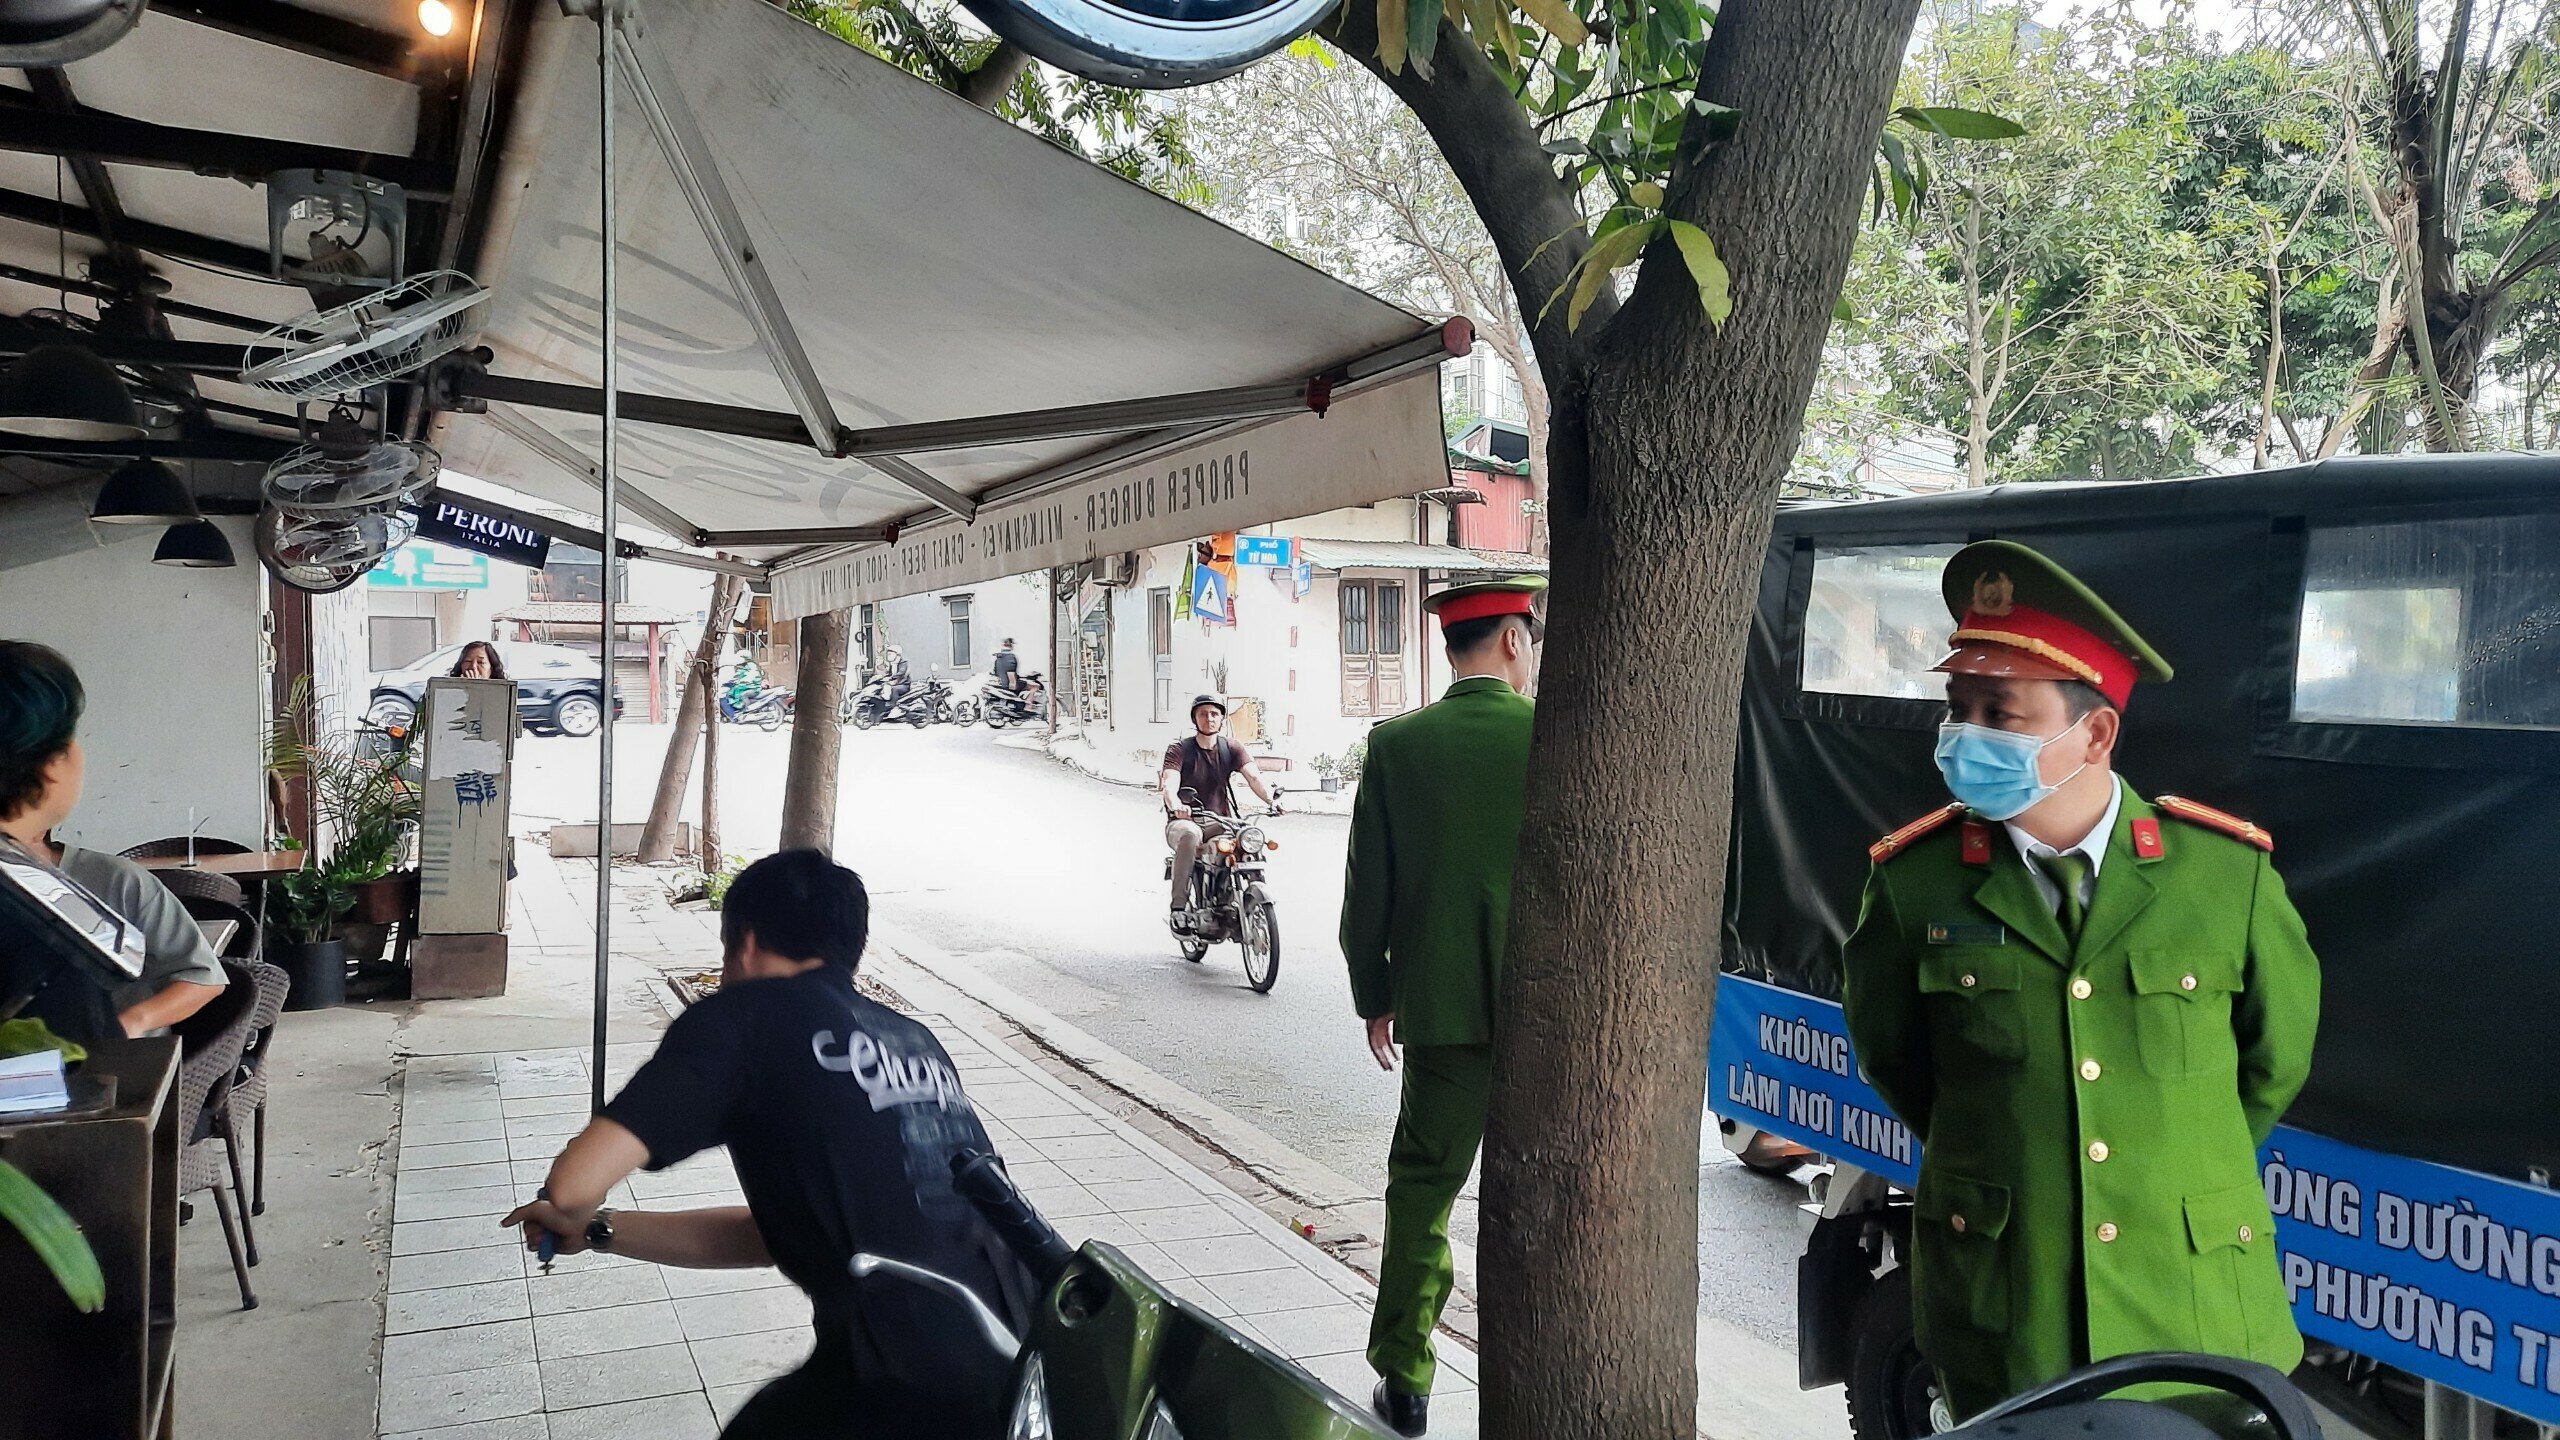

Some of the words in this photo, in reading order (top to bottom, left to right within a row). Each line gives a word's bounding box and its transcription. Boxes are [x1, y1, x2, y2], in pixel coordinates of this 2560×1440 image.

[436, 503, 535, 547] PERONI
[462, 532, 501, 548] ITALIA
[1728, 1062, 1781, 1117] LÀM
[1788, 1085, 1835, 1137] NƠI
[1842, 1103, 1912, 1166] KINH
[2284, 1251, 2495, 1372] PHƯƠNG
[1759, 1012, 1849, 1077] KHÔNG
[2263, 1150, 2361, 1238] ÒNG
[2376, 1192, 2560, 1298] ĐƯỜNG
